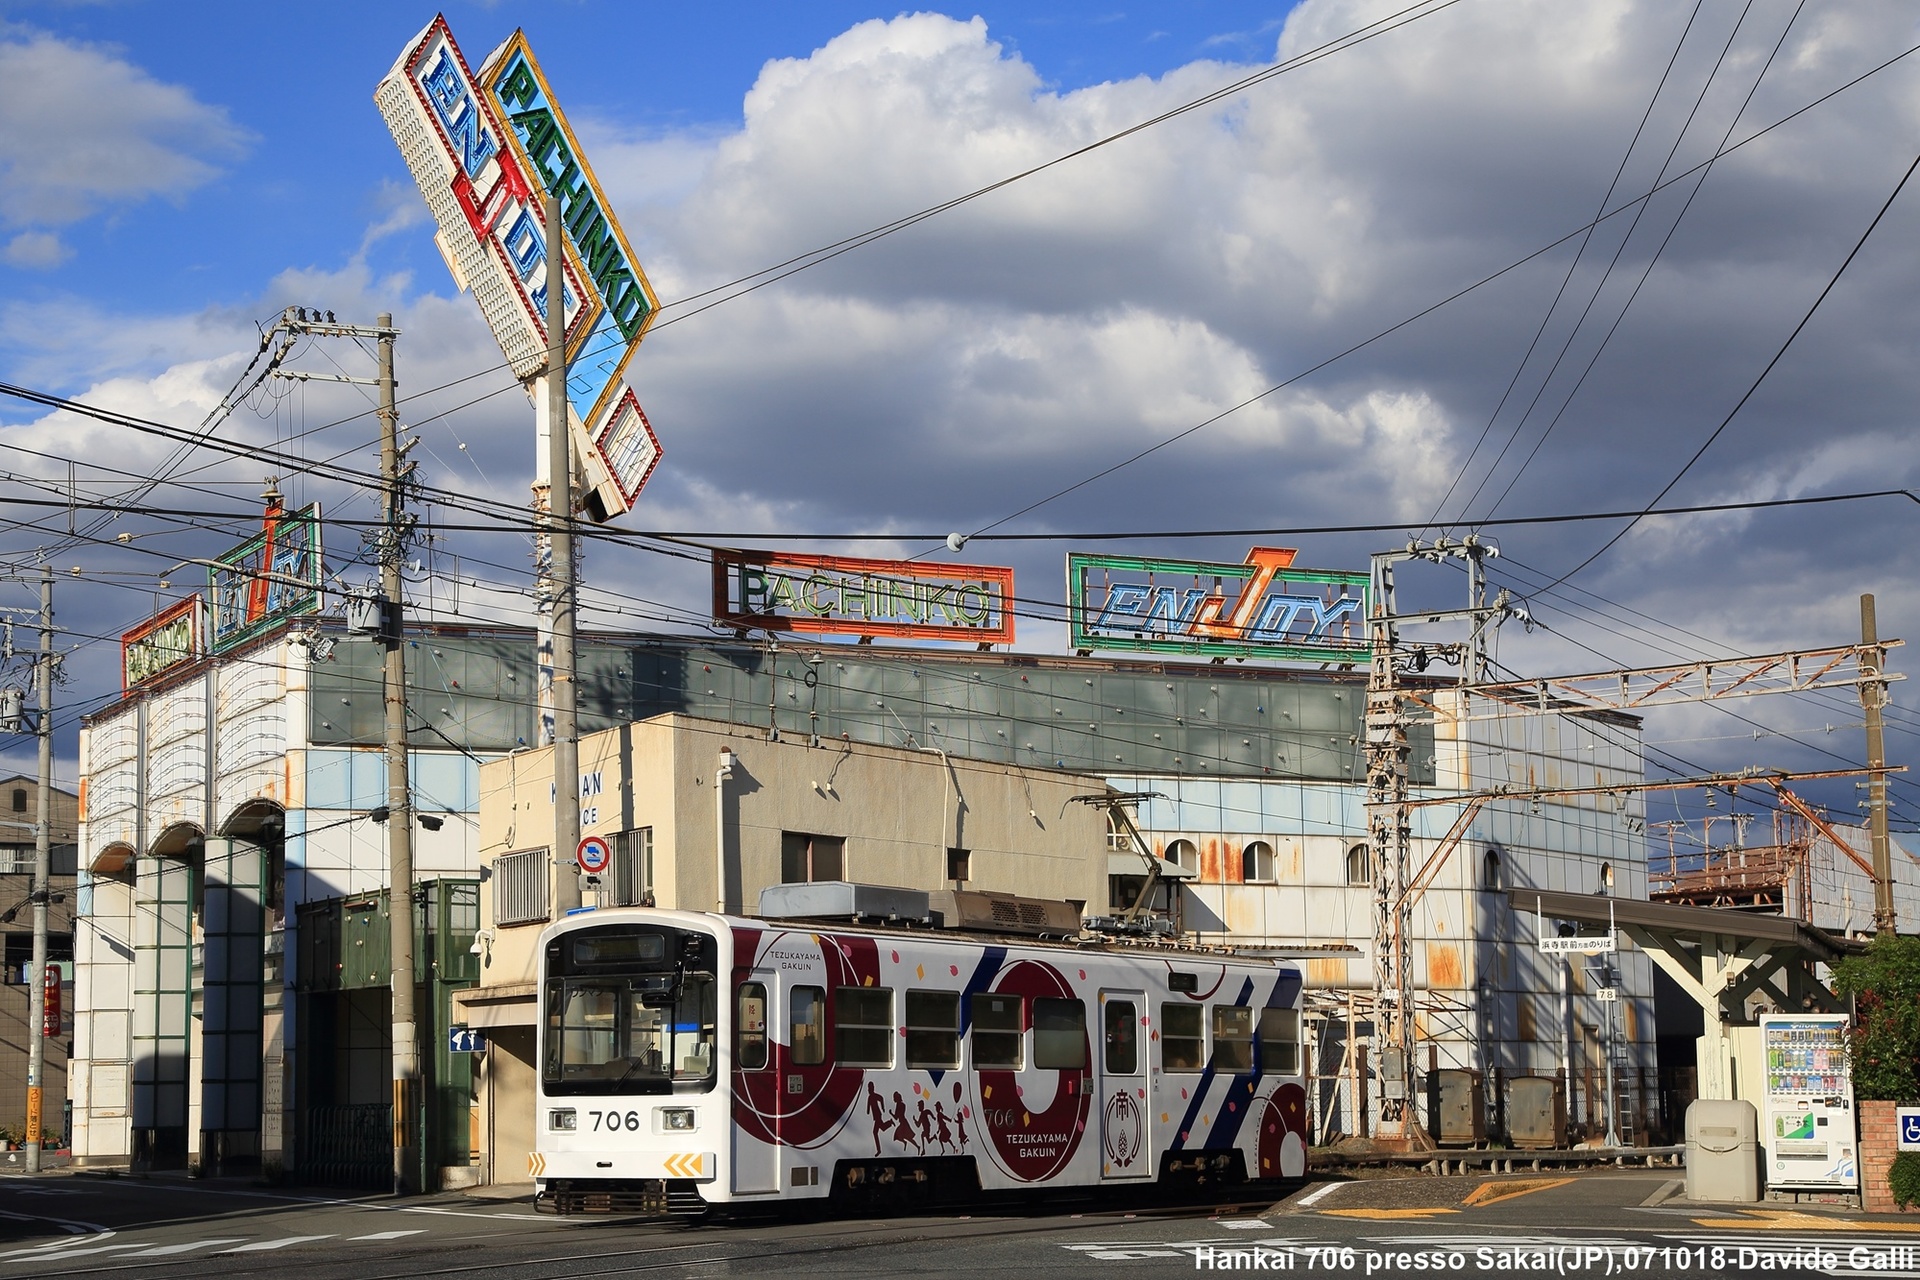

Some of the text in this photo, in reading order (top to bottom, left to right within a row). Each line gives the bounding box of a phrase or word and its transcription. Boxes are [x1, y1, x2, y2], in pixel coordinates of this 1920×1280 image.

[422, 46, 573, 319] ENJOY
[501, 59, 651, 343] PACHINKO
[743, 570, 990, 624] PACHINKO
[1088, 546, 1362, 643] ENJOY
[770, 951, 820, 960] TEZUKAYAMA
[1599, 990, 1613, 999] 78
[30, 1088, 39, 1136] スピード落とせ
[589, 1110, 640, 1132] 706
[984, 1108, 1015, 1128] 706
[1006, 1133, 1068, 1144] TEZUKAYAMA
[1020, 1147, 1056, 1158] GAKUIN
